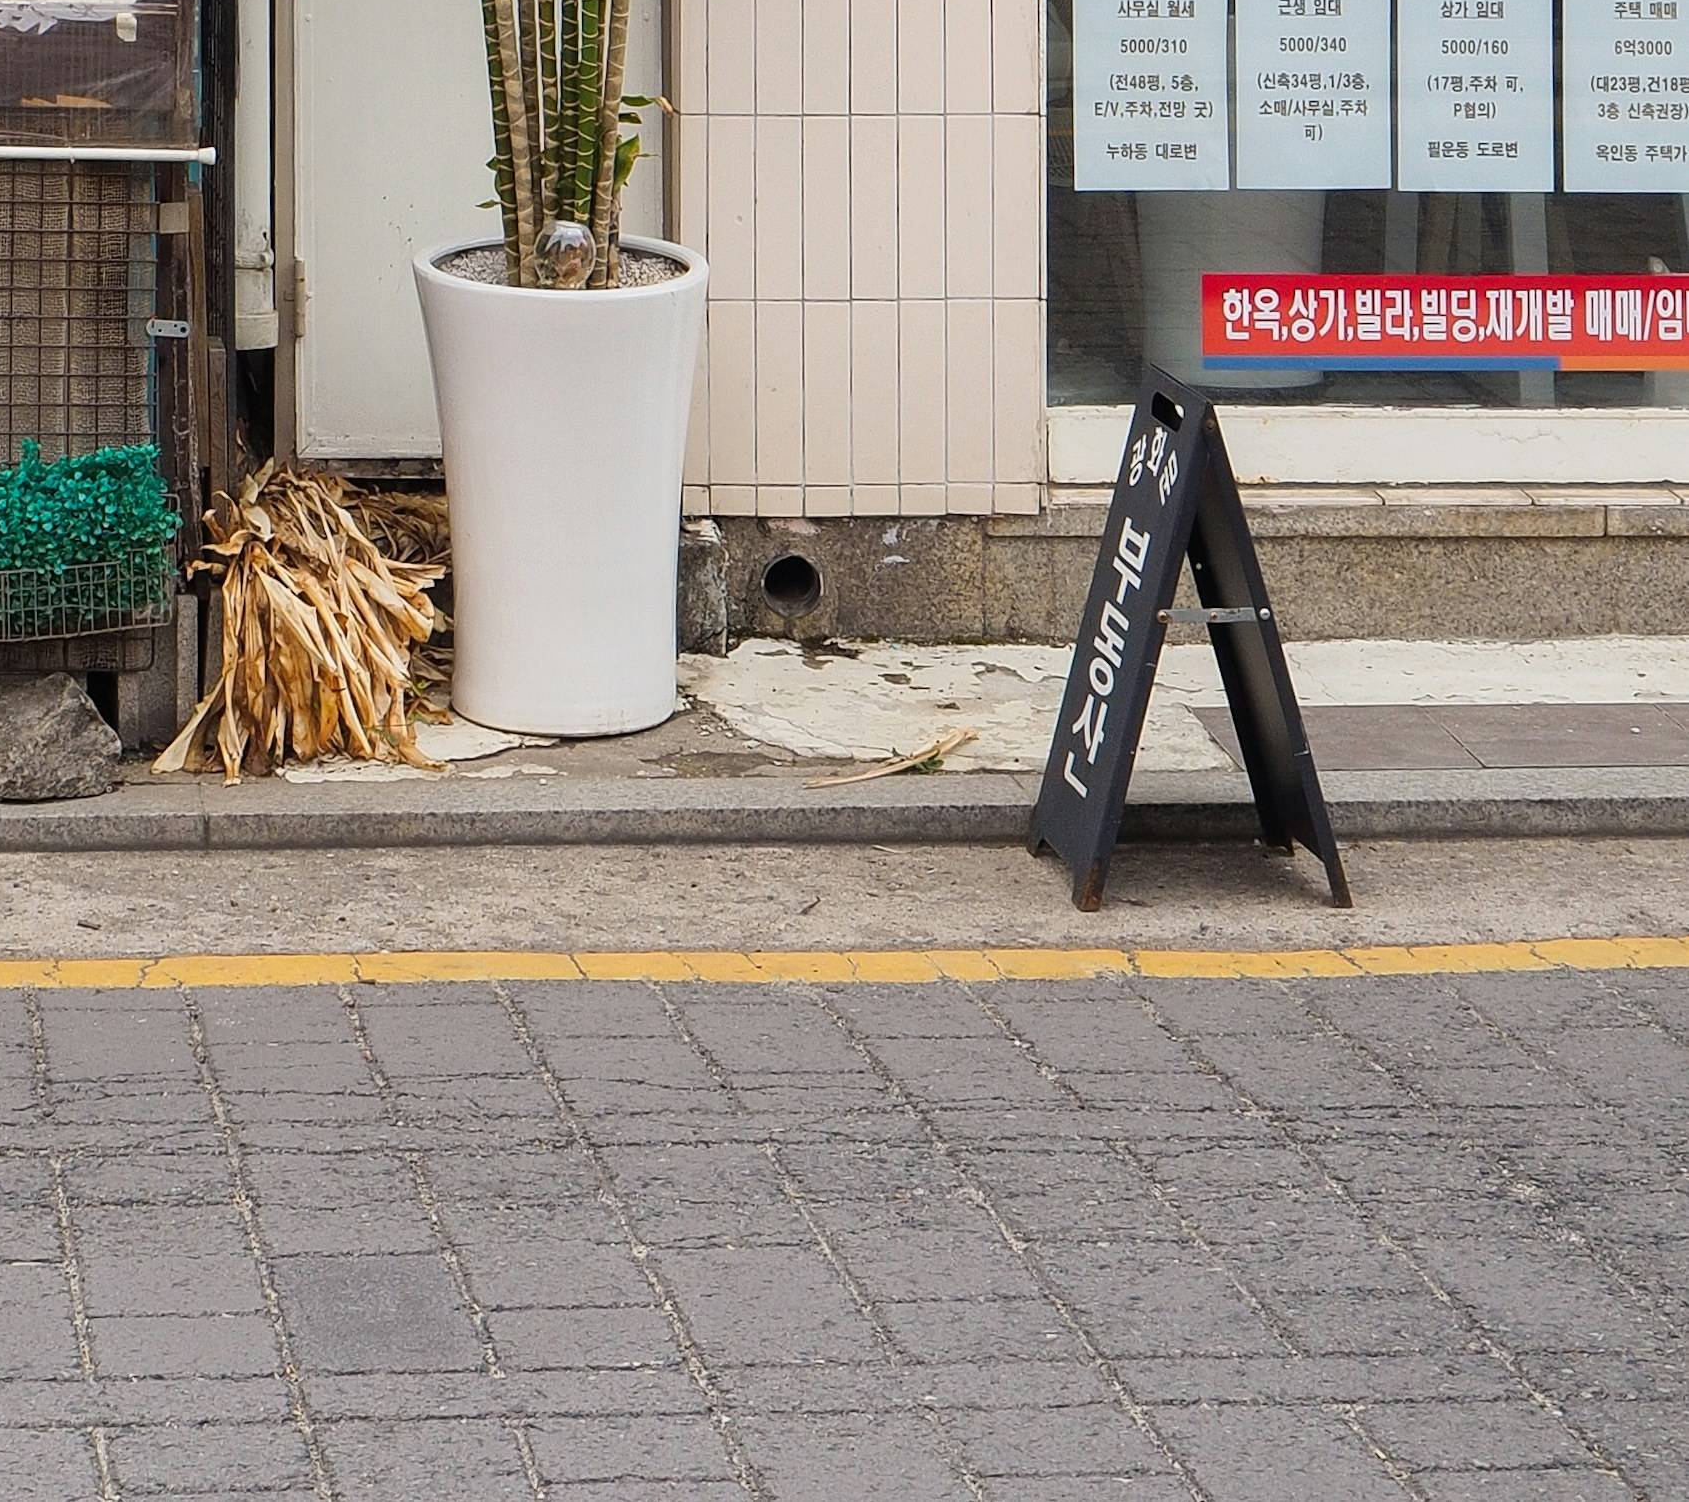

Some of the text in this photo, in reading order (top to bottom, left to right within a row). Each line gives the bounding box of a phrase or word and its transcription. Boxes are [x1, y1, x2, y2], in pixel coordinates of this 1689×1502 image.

[1118, 0, 1194, 18] 사무실 월세
[1278, 0, 1307, 16] 근생
[1441, 1, 1503, 18] 상가 임대
[1615, 2, 1677, 19] 주택 매매
[1121, 38, 1187, 54] 5000/310
[1280, 36, 1346, 52] 5000/340
[1442, 39, 1508, 55] 5000/160
[1615, 40, 1671, 56] 6억3000
[1110, 74, 1198, 91] (전48평, 5층,
[1258, 73, 1369, 90] (신축34평,1/3층,
[1428, 75, 1523, 92] (17평,주차 可,
[1095, 101, 1212, 118] E/V,주차,전망 굿)
[1259, 99, 1367, 116] 소매/사무실,주차
[1454, 102, 1495, 119] P협의)
[1598, 103, 1688, 120] 3층 신축권장)
[1304, 124, 1322, 140] 可)
[1106, 143, 1196, 160] 누하동 대로변
[1428, 141, 1517, 158] 필운동 도로변
[1596, 145, 1687, 162] 옥인동 주택가
[1222, 287, 1574, 343] 한옥,상가,빌라,빌딩,재개발
[1128, 426, 1180, 505] 광화문
[1063, 517, 1150, 798] 부동산
